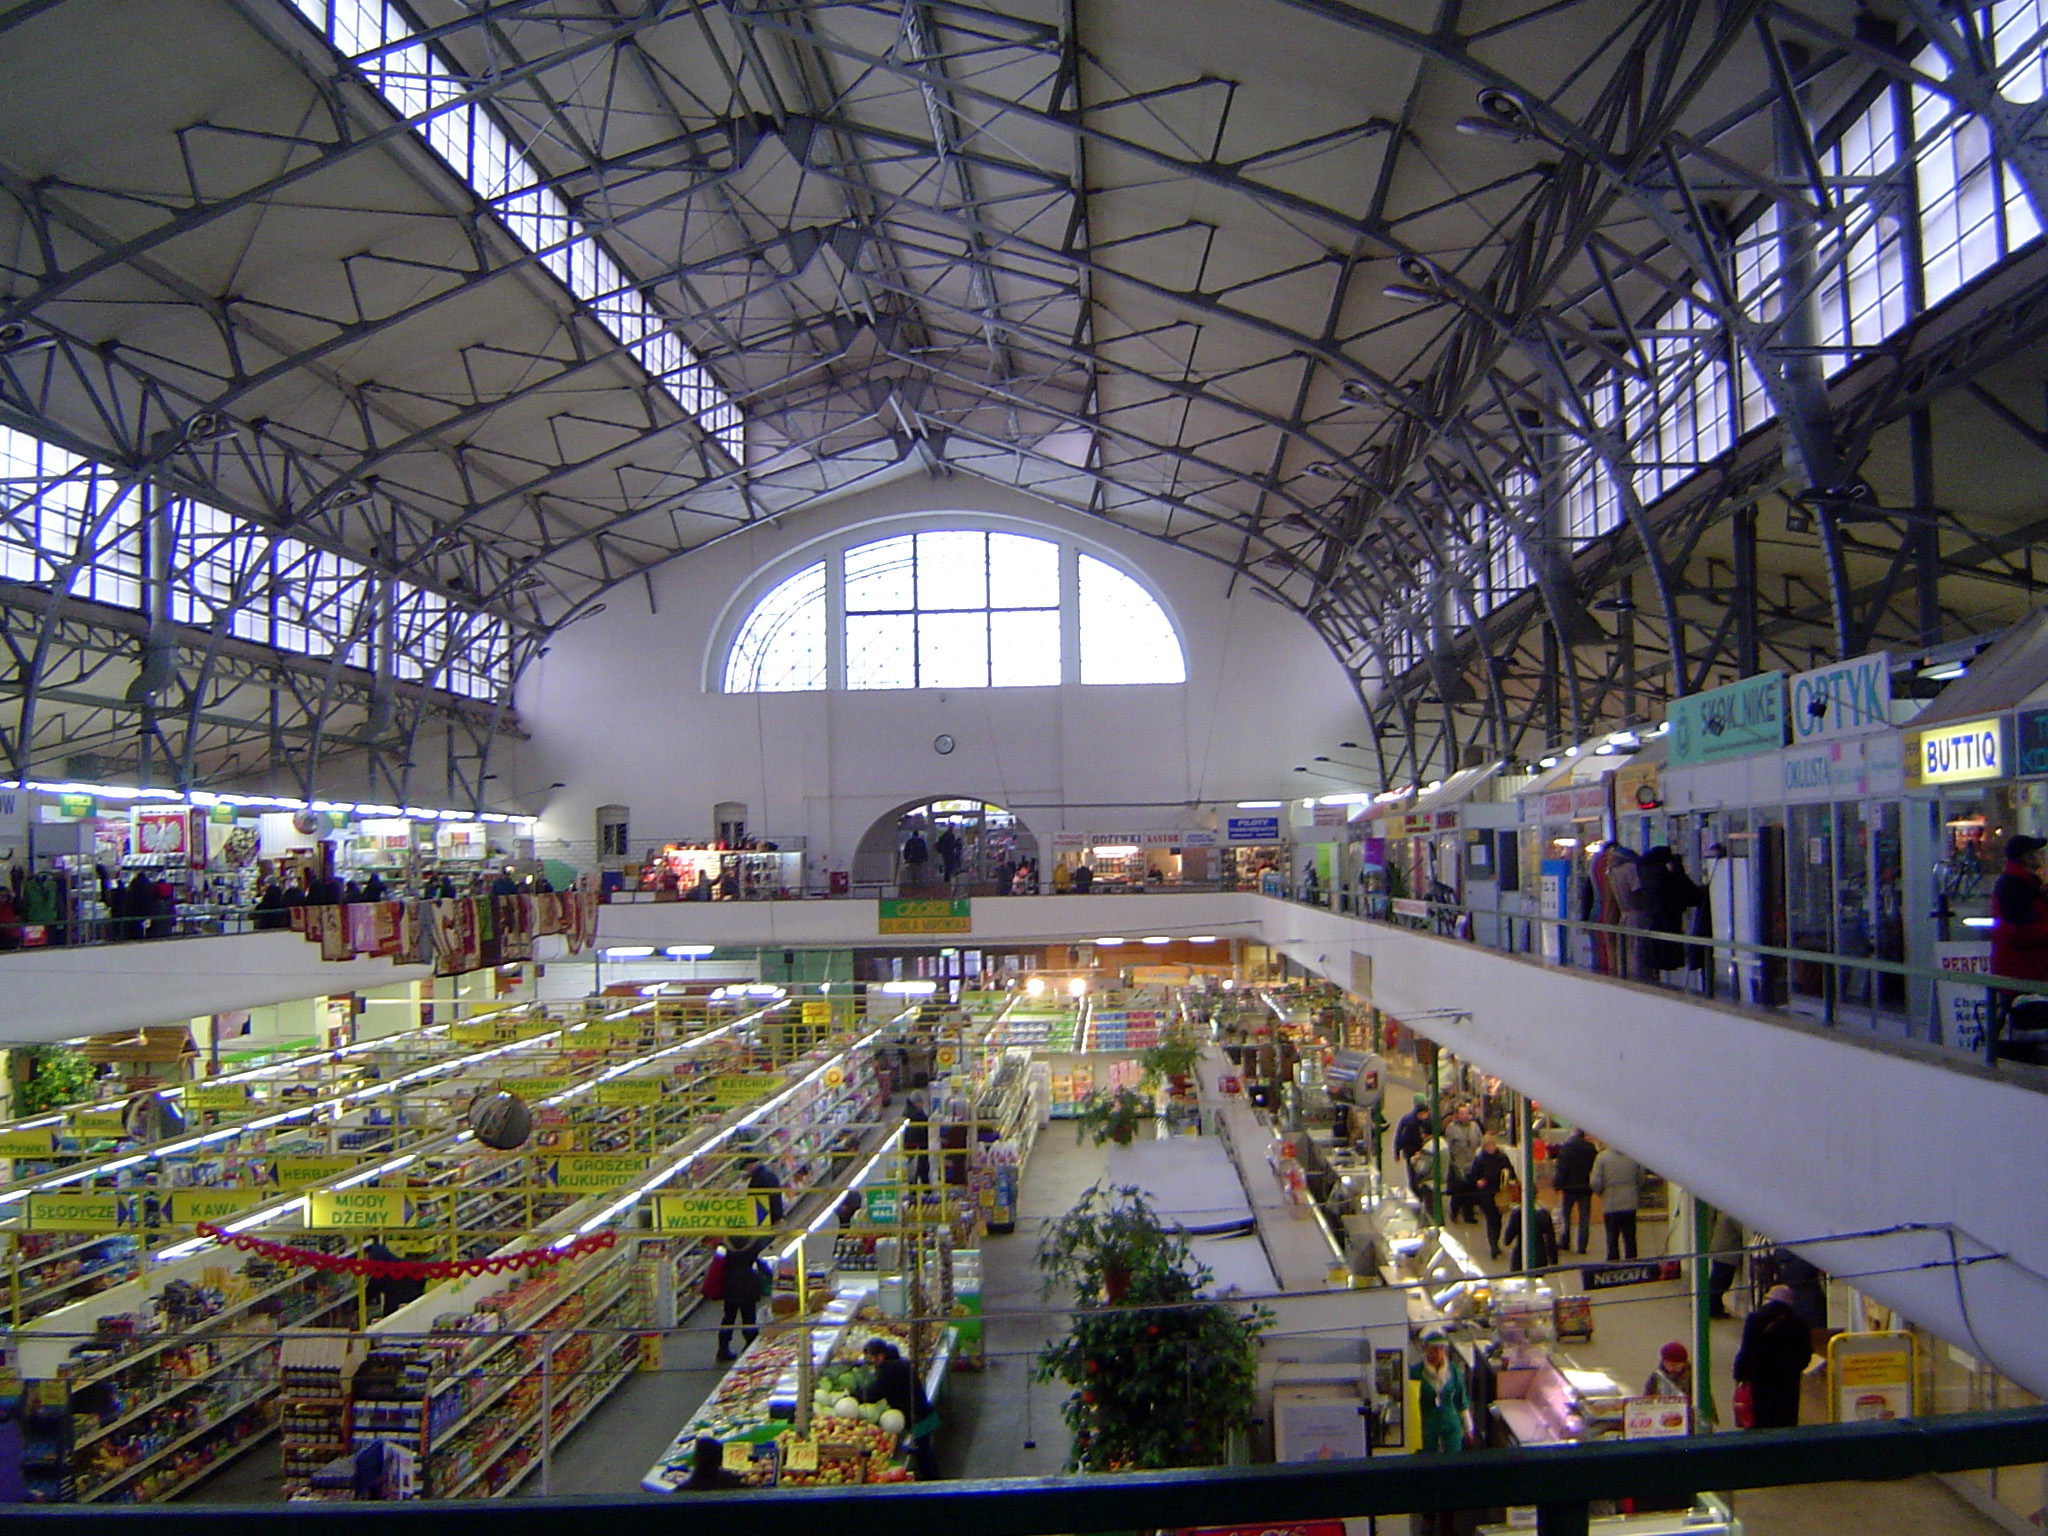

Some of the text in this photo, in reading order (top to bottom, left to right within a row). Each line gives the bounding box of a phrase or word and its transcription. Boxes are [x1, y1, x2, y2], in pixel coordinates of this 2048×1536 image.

[1794, 660, 1884, 737] OPTYK
[1926, 731, 1997, 774] BUTTIQ
[721, 1078, 775, 1088] KETCHUP
[573, 1159, 643, 1172] GROSZEK
[336, 1195, 387, 1208] MIODY
[683, 1199, 748, 1212] OWOCE
[36, 1204, 116, 1219] SŁODYCZE
[191, 1203, 239, 1216] KAWA
[332, 1209, 389, 1225] DŻEMY
[667, 1215, 748, 1228] WARZYWA
